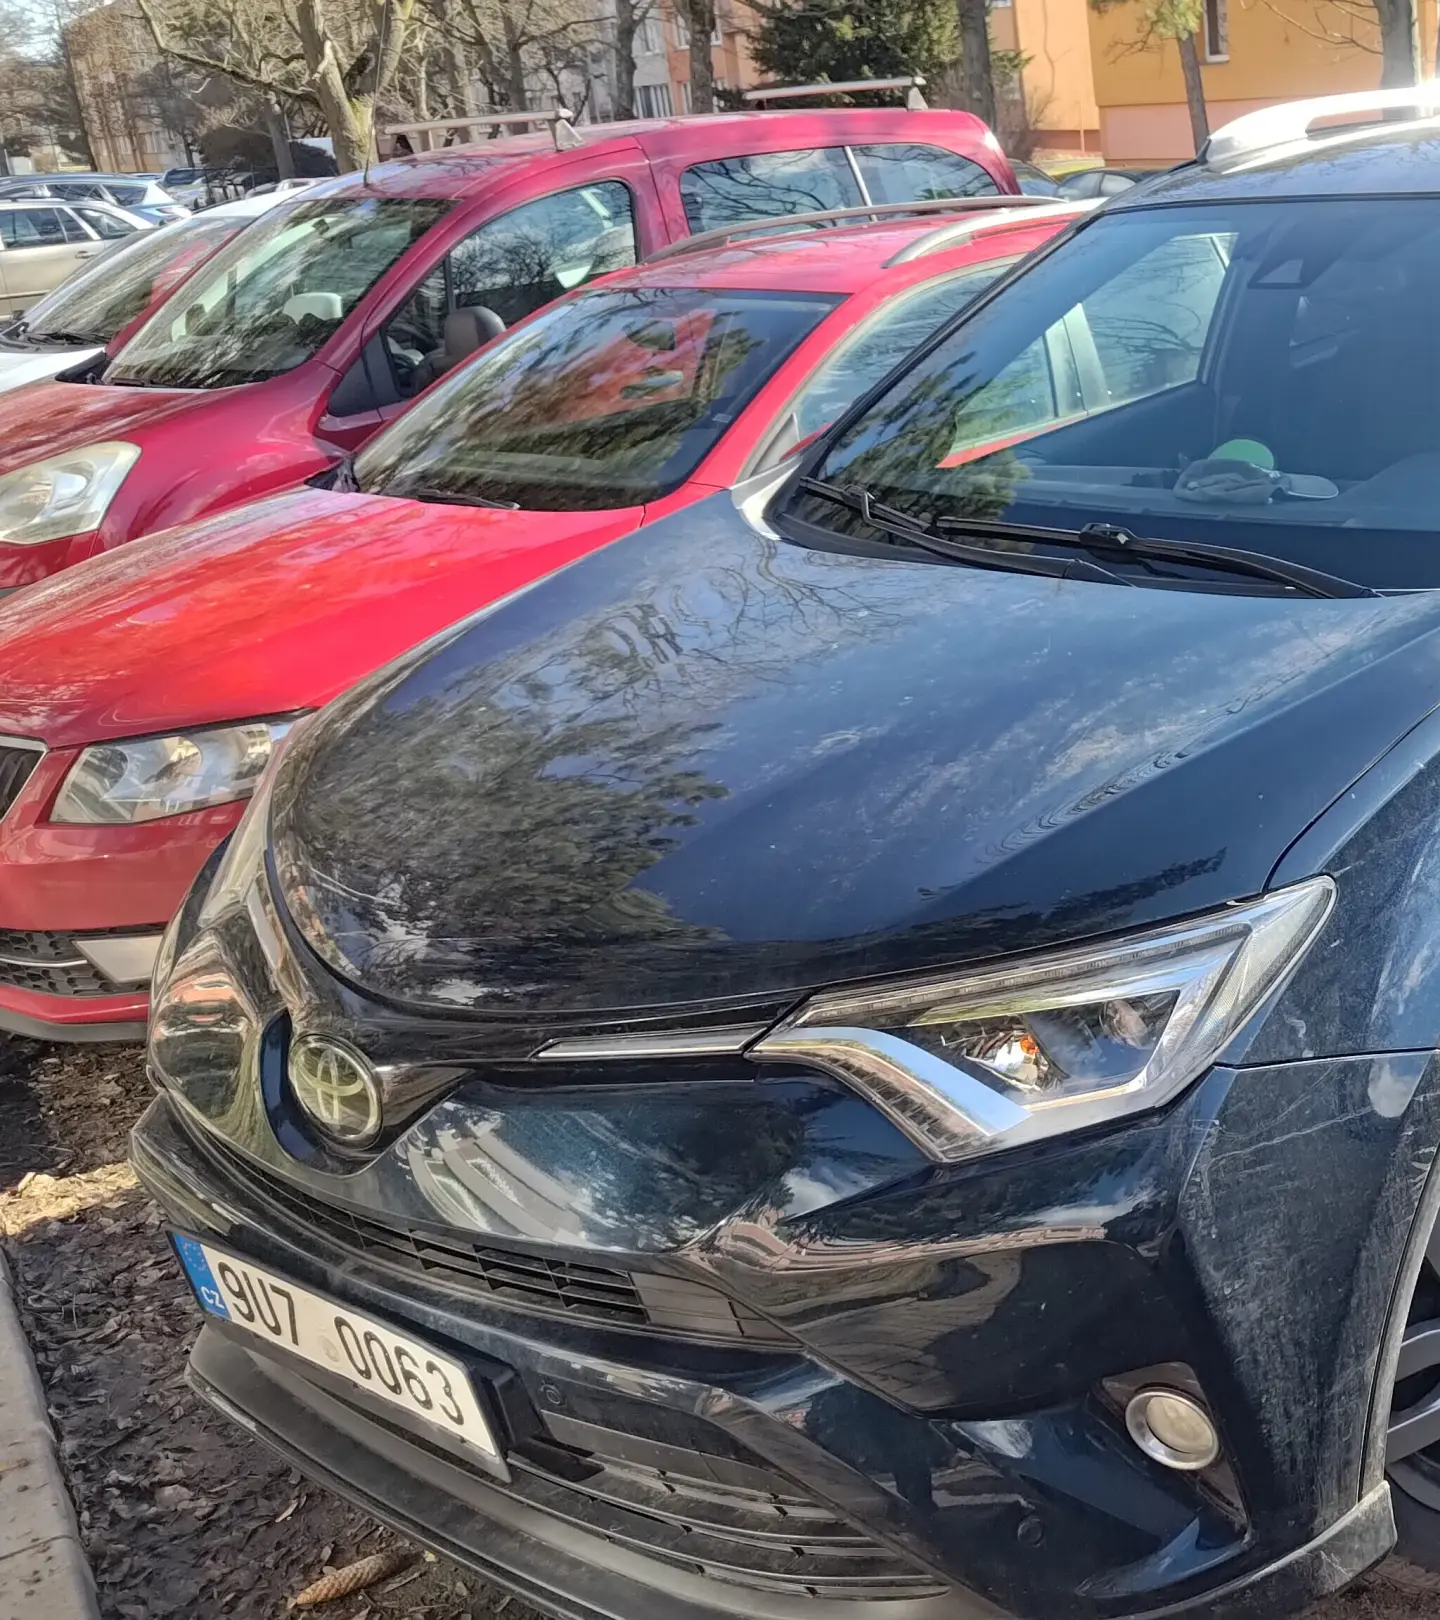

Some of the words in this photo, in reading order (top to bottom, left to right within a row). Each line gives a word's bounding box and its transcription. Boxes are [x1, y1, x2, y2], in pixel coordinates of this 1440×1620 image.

[200, 1285, 225, 1309] CZ
[217, 1261, 299, 1346] 9U7
[333, 1316, 465, 1425] 0063
